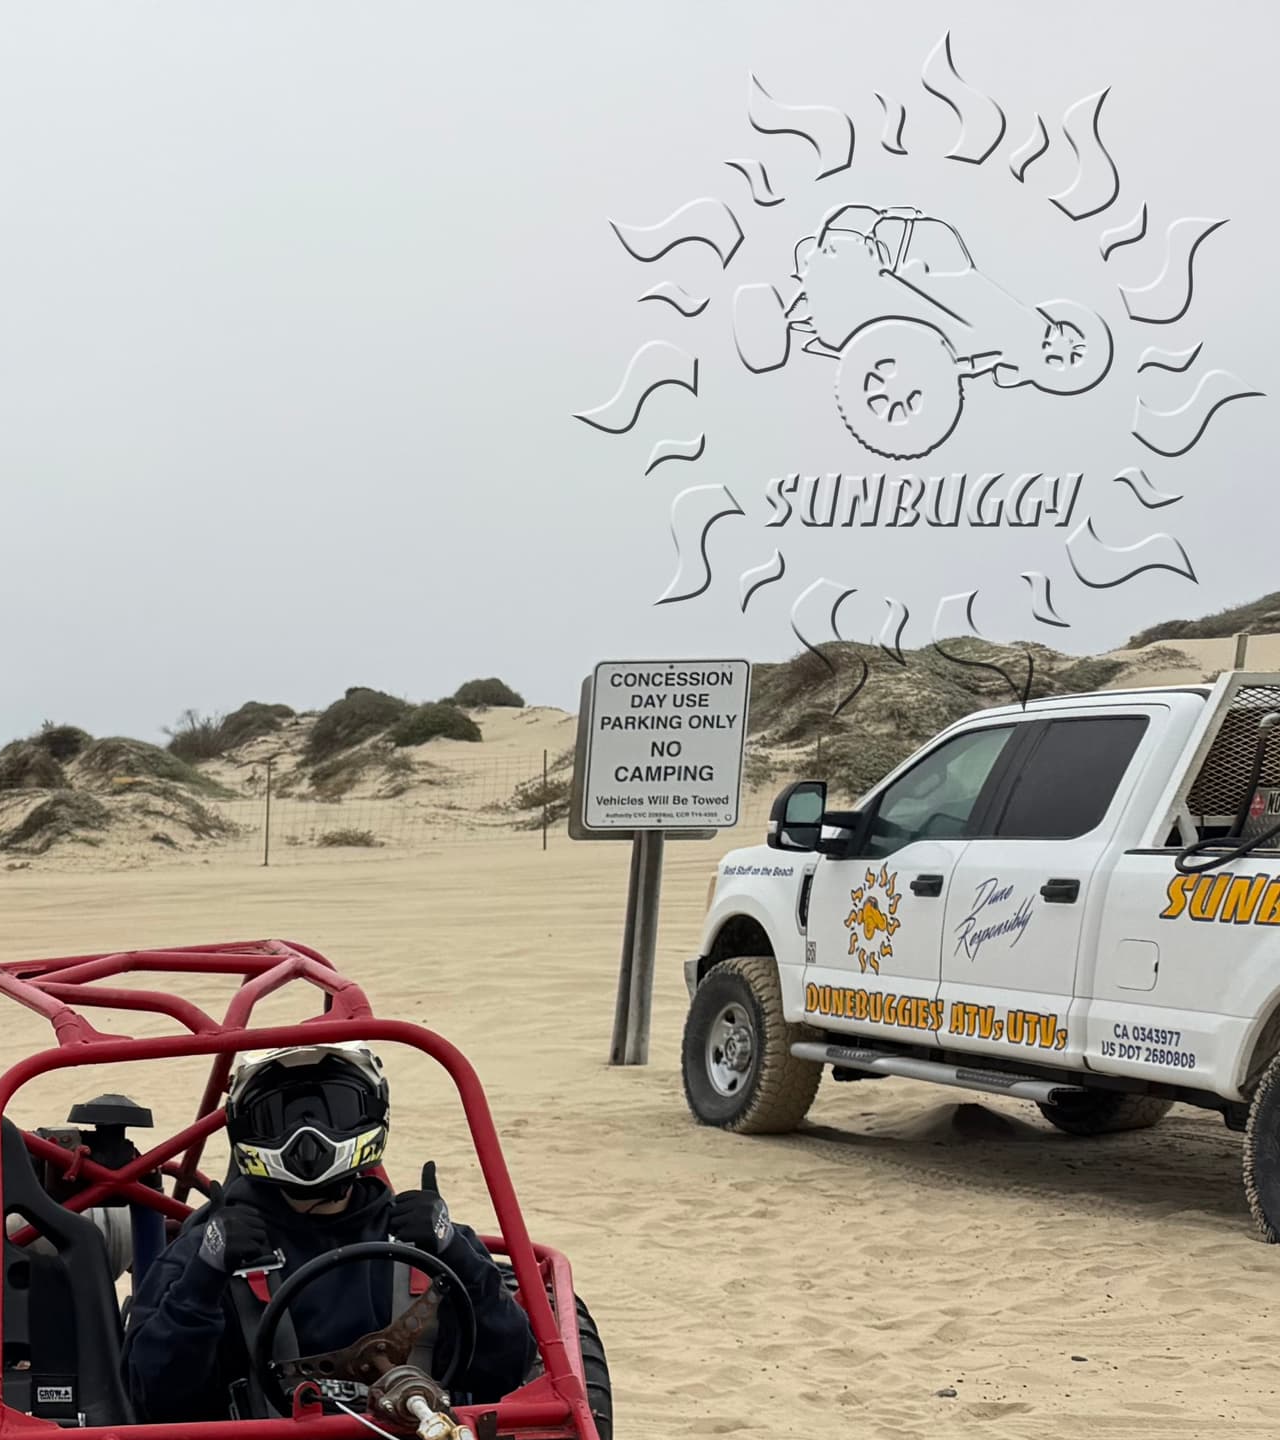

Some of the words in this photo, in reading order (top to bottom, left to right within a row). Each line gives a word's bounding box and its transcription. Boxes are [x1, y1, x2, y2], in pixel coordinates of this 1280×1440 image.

[610, 671, 733, 687] CONCESSION
[631, 694, 667, 708] DAY
[673, 693, 709, 707] USE
[600, 716, 682, 730] PARKING
[688, 714, 737, 729] ONLY
[651, 741, 682, 757] NO
[614, 765, 714, 782] CAMPING
[596, 795, 644, 806] Vehicles
[647, 795, 669, 805] Will
[672, 795, 688, 805] Be
[691, 795, 729, 805] Towed
[772, 867, 794, 876] Beach
[969, 878, 1014, 918] Dune
[954, 894, 1036, 962] Responsibly
[949, 1001, 1004, 1041] ATVs
[1006, 1009, 1068, 1051] UTVs
[1114, 1024, 1129, 1040] CA
[1132, 1026, 1181, 1047] 0343977
[1101, 1040, 1116, 1056] US
[1119, 1043, 1142, 1060] DOT
[1144, 1047, 1196, 1069] 2680808
